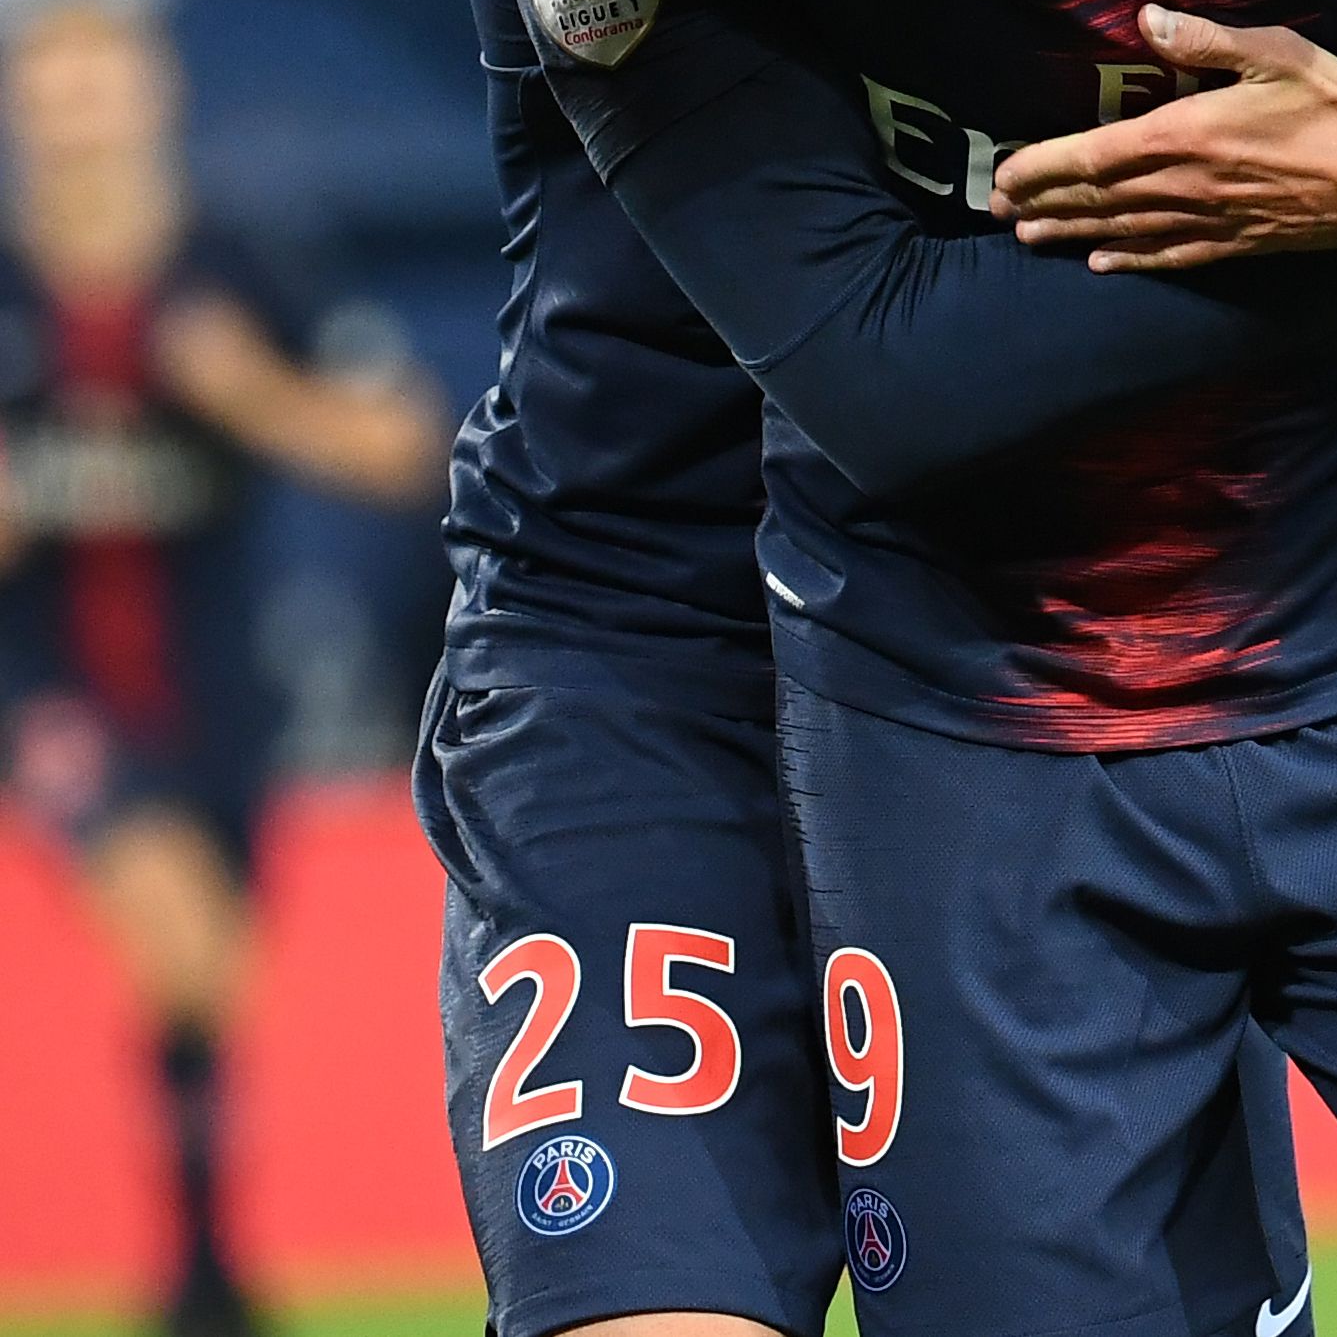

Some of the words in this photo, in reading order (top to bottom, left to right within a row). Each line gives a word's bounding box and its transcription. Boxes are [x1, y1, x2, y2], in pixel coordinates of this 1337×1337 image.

[559, 0, 619, 31] LIGUE
[564, 18, 644, 45] Conforama
[477, 922, 742, 1153] 25
[823, 946, 904, 1167] 9
[532, 1141, 596, 1170] PARIS
[850, 1193, 889, 1219] PARIS
